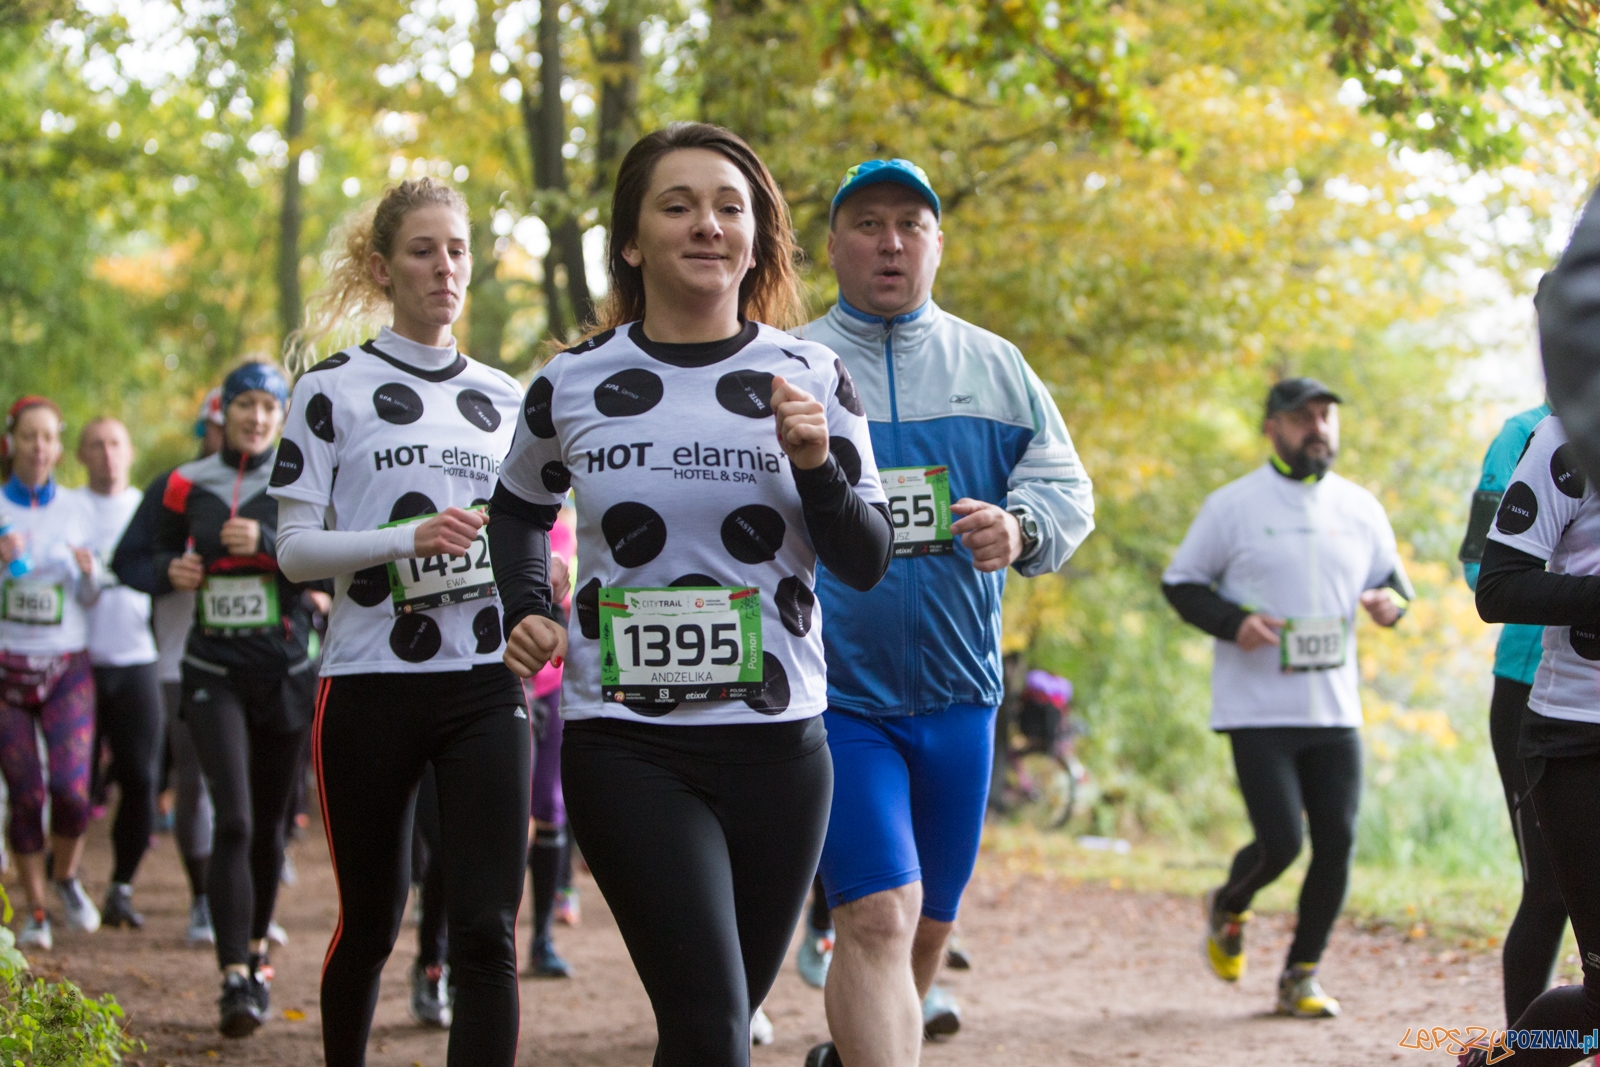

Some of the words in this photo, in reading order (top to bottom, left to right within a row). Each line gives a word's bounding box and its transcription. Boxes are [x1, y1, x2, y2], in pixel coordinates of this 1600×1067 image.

[443, 467, 469, 479] HOTEL
[475, 472, 489, 484] SPA
[673, 469, 719, 482] HOTEL
[720, 470, 731, 482] &
[733, 472, 757, 485] SPA
[445, 577, 467, 589] EWA
[210, 594, 262, 618] 1652
[623, 623, 740, 667] 1395
[747, 631, 757, 670] Poznań
